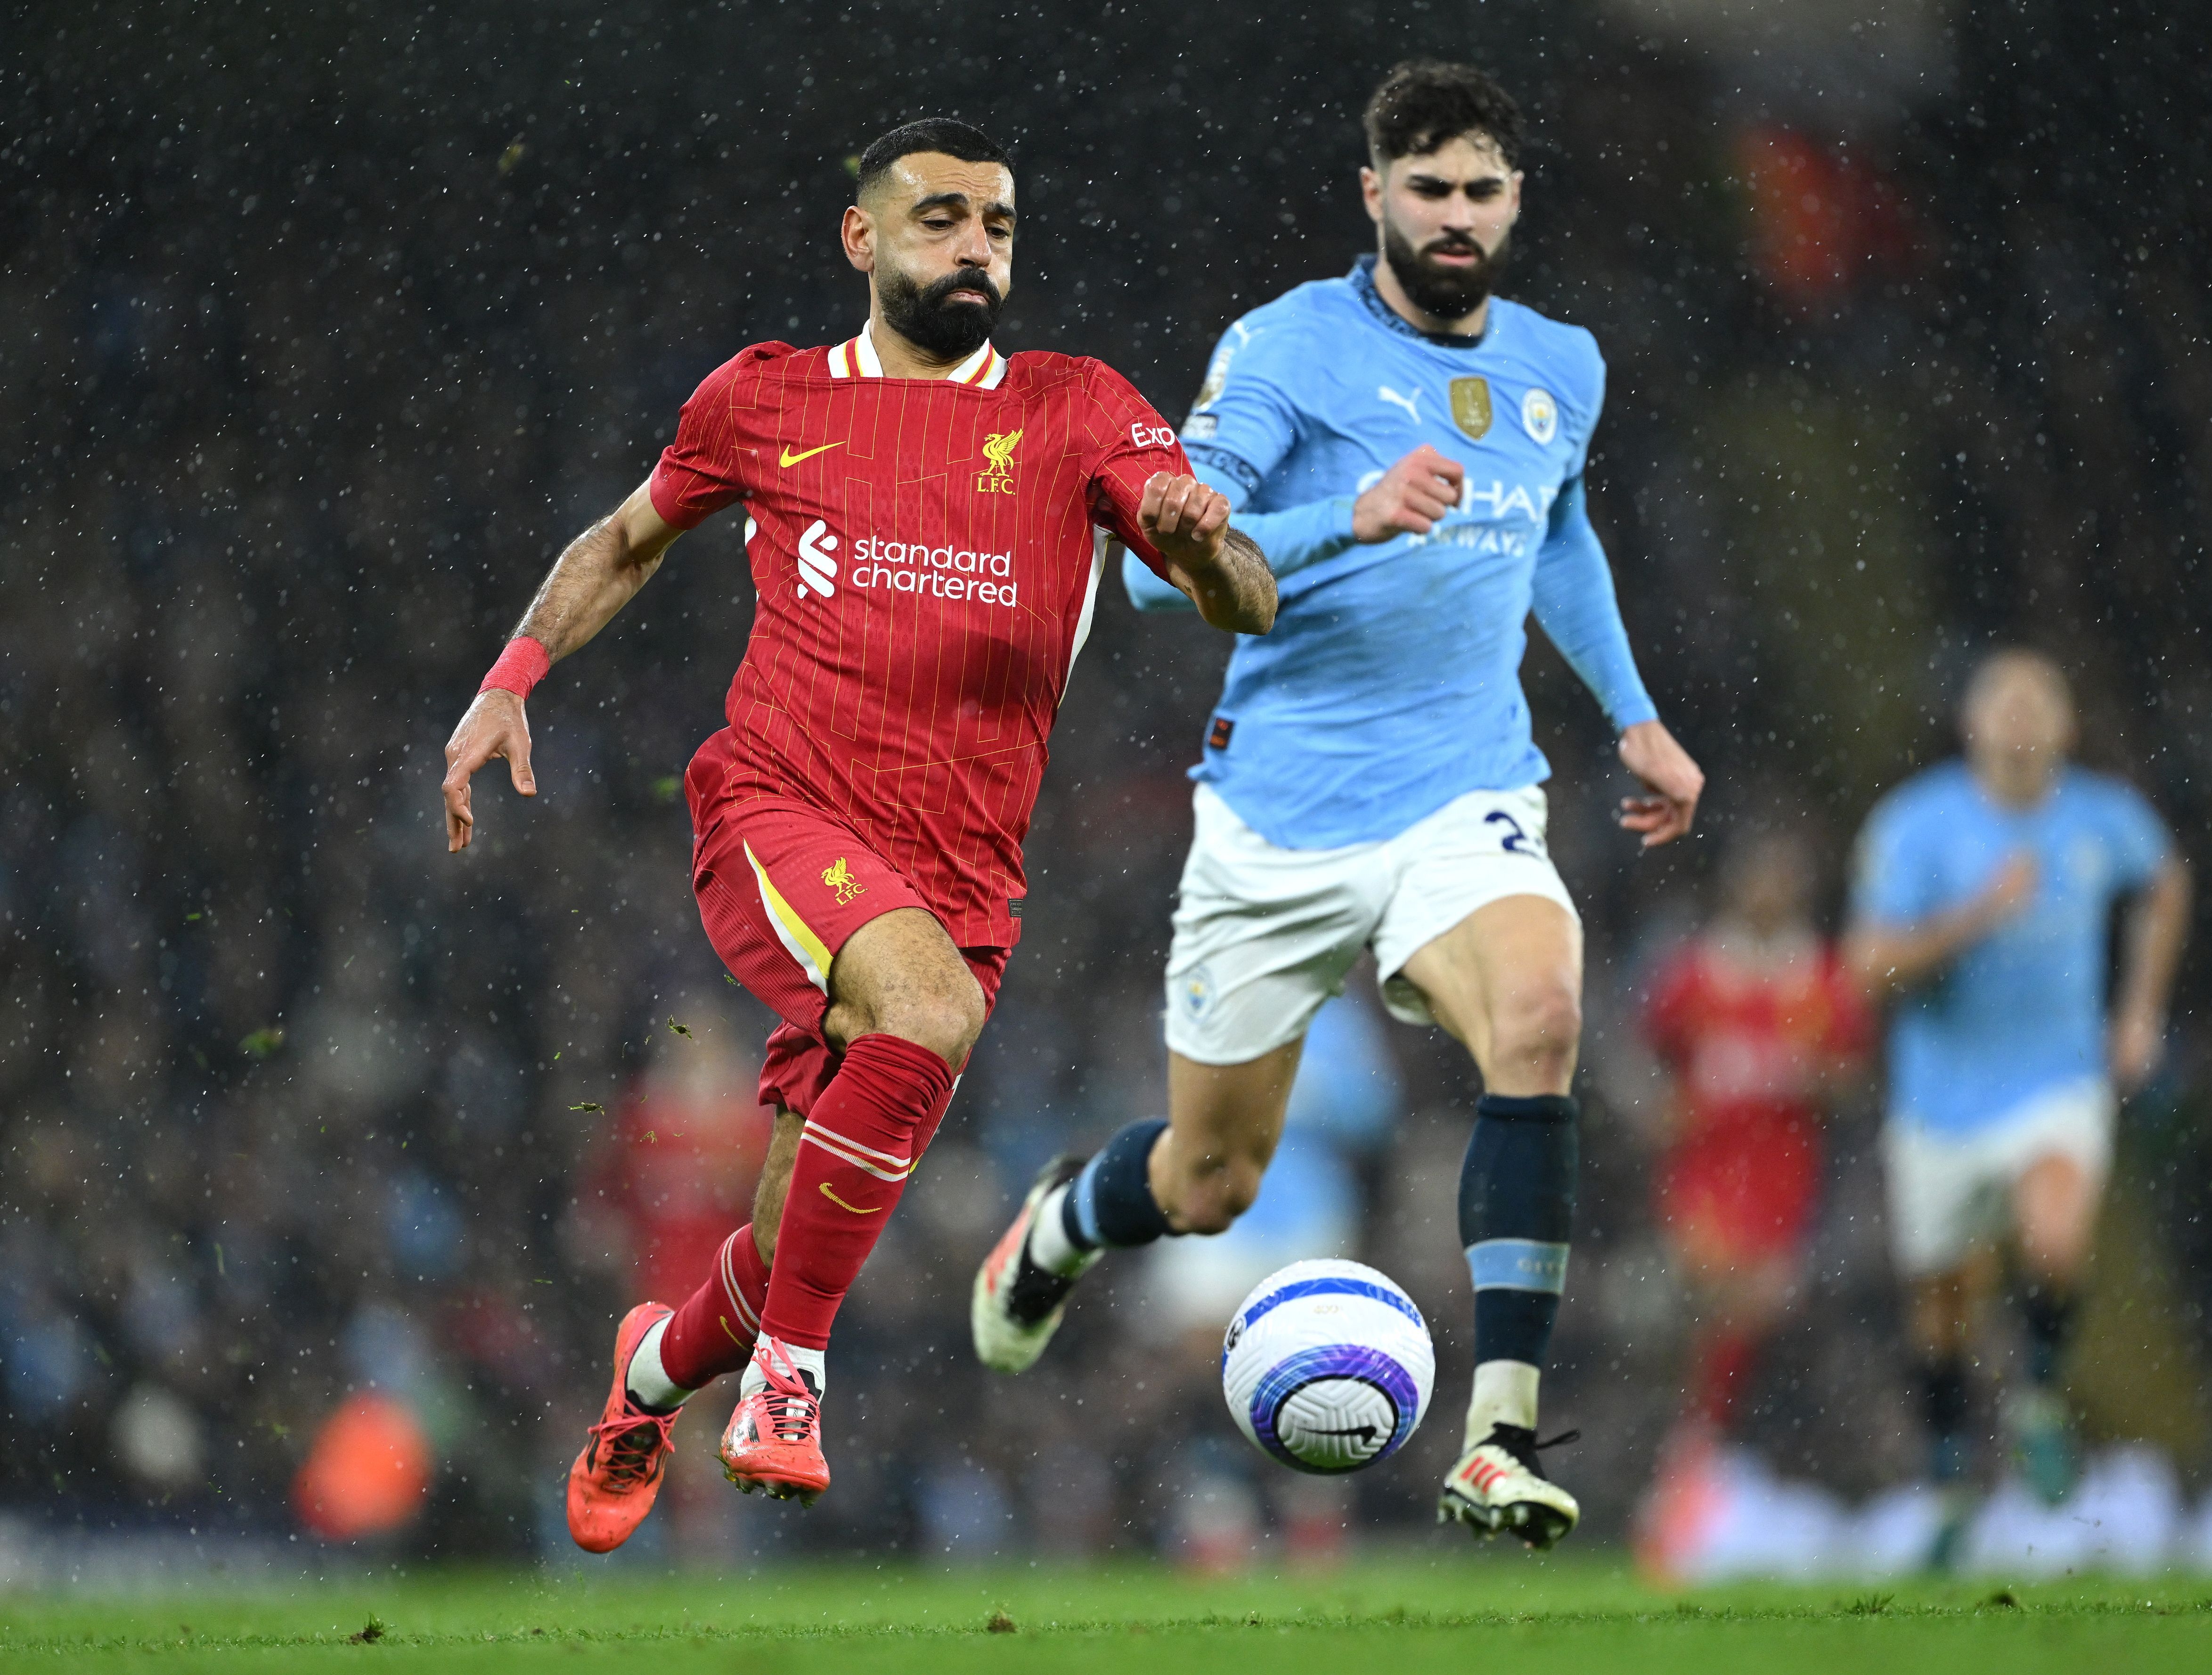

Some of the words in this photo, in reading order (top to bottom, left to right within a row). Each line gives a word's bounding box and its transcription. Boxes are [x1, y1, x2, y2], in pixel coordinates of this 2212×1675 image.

[977, 477, 1016, 495] L.F.C.
[854, 535, 1011, 577] standard
[852, 562, 1017, 608] chartered
[835, 883, 868, 906] L.F.C.
